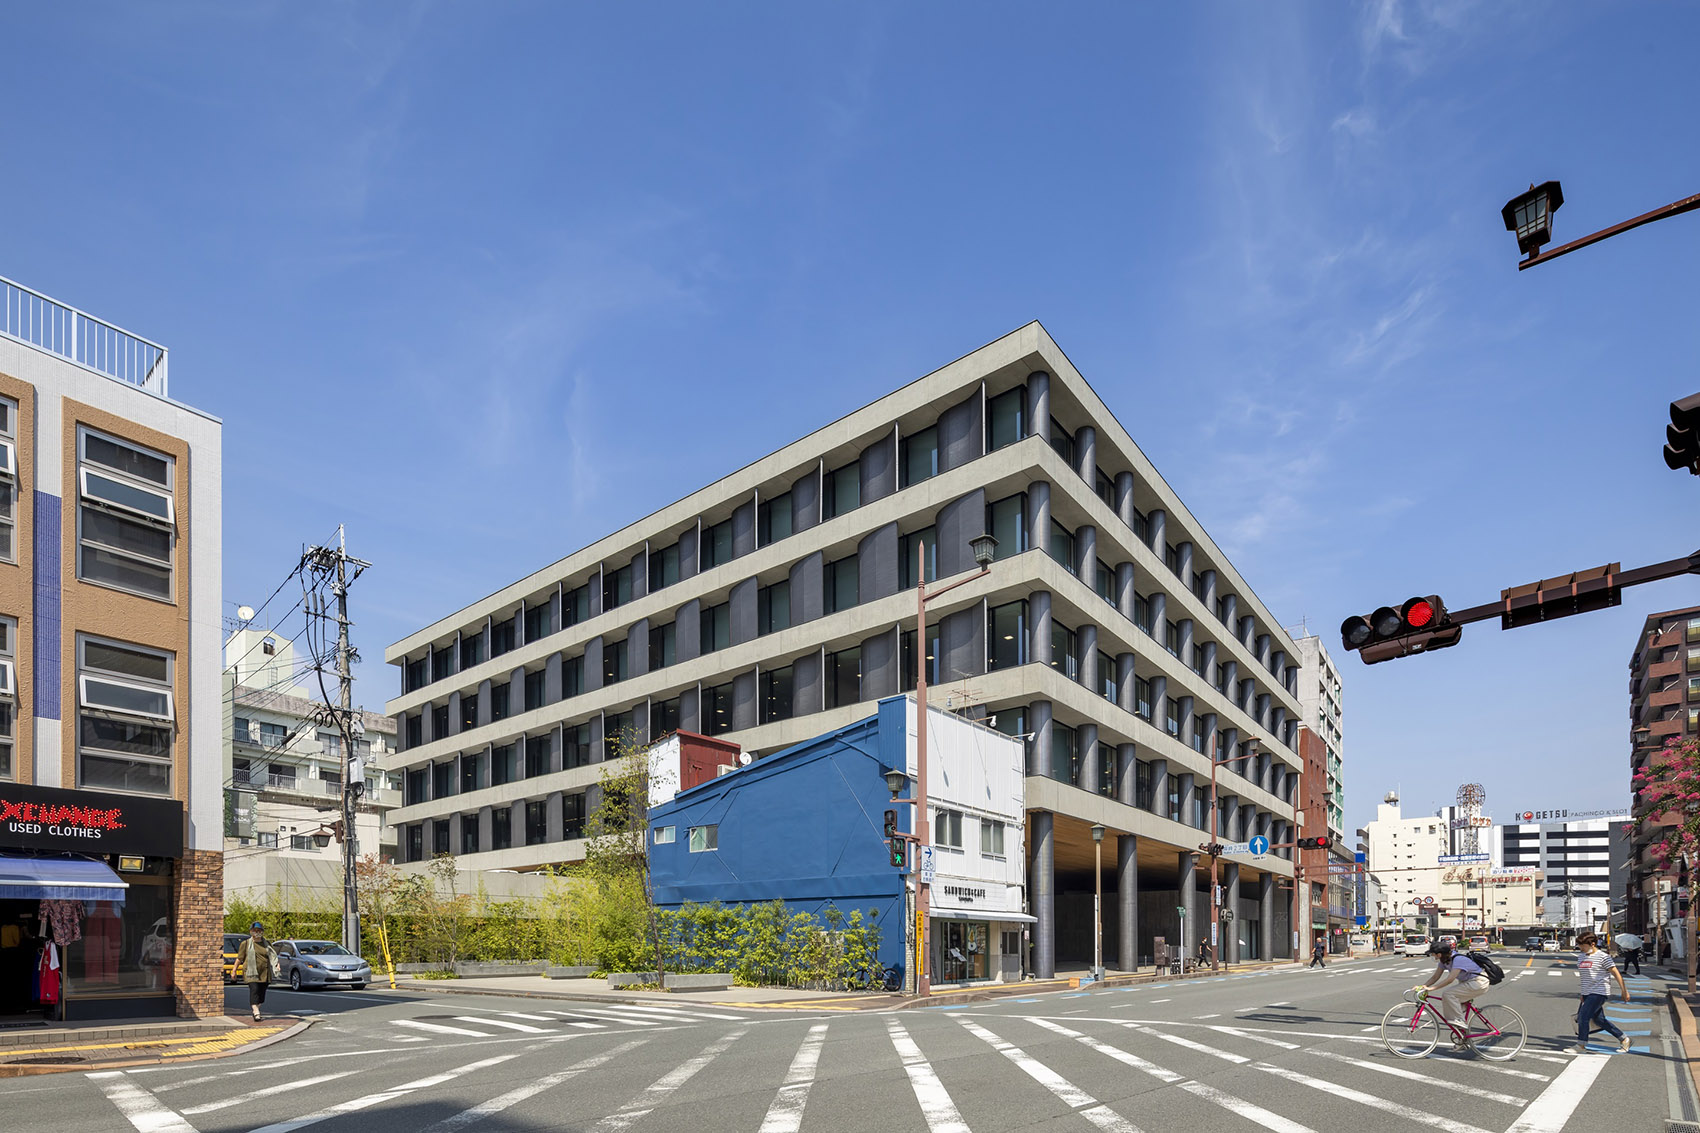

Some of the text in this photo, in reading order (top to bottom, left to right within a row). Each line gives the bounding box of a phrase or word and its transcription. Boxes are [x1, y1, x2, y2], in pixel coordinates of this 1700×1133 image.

[0, 799, 127, 831] XCHANGE
[9, 822, 102, 839] USED CLOTHES
